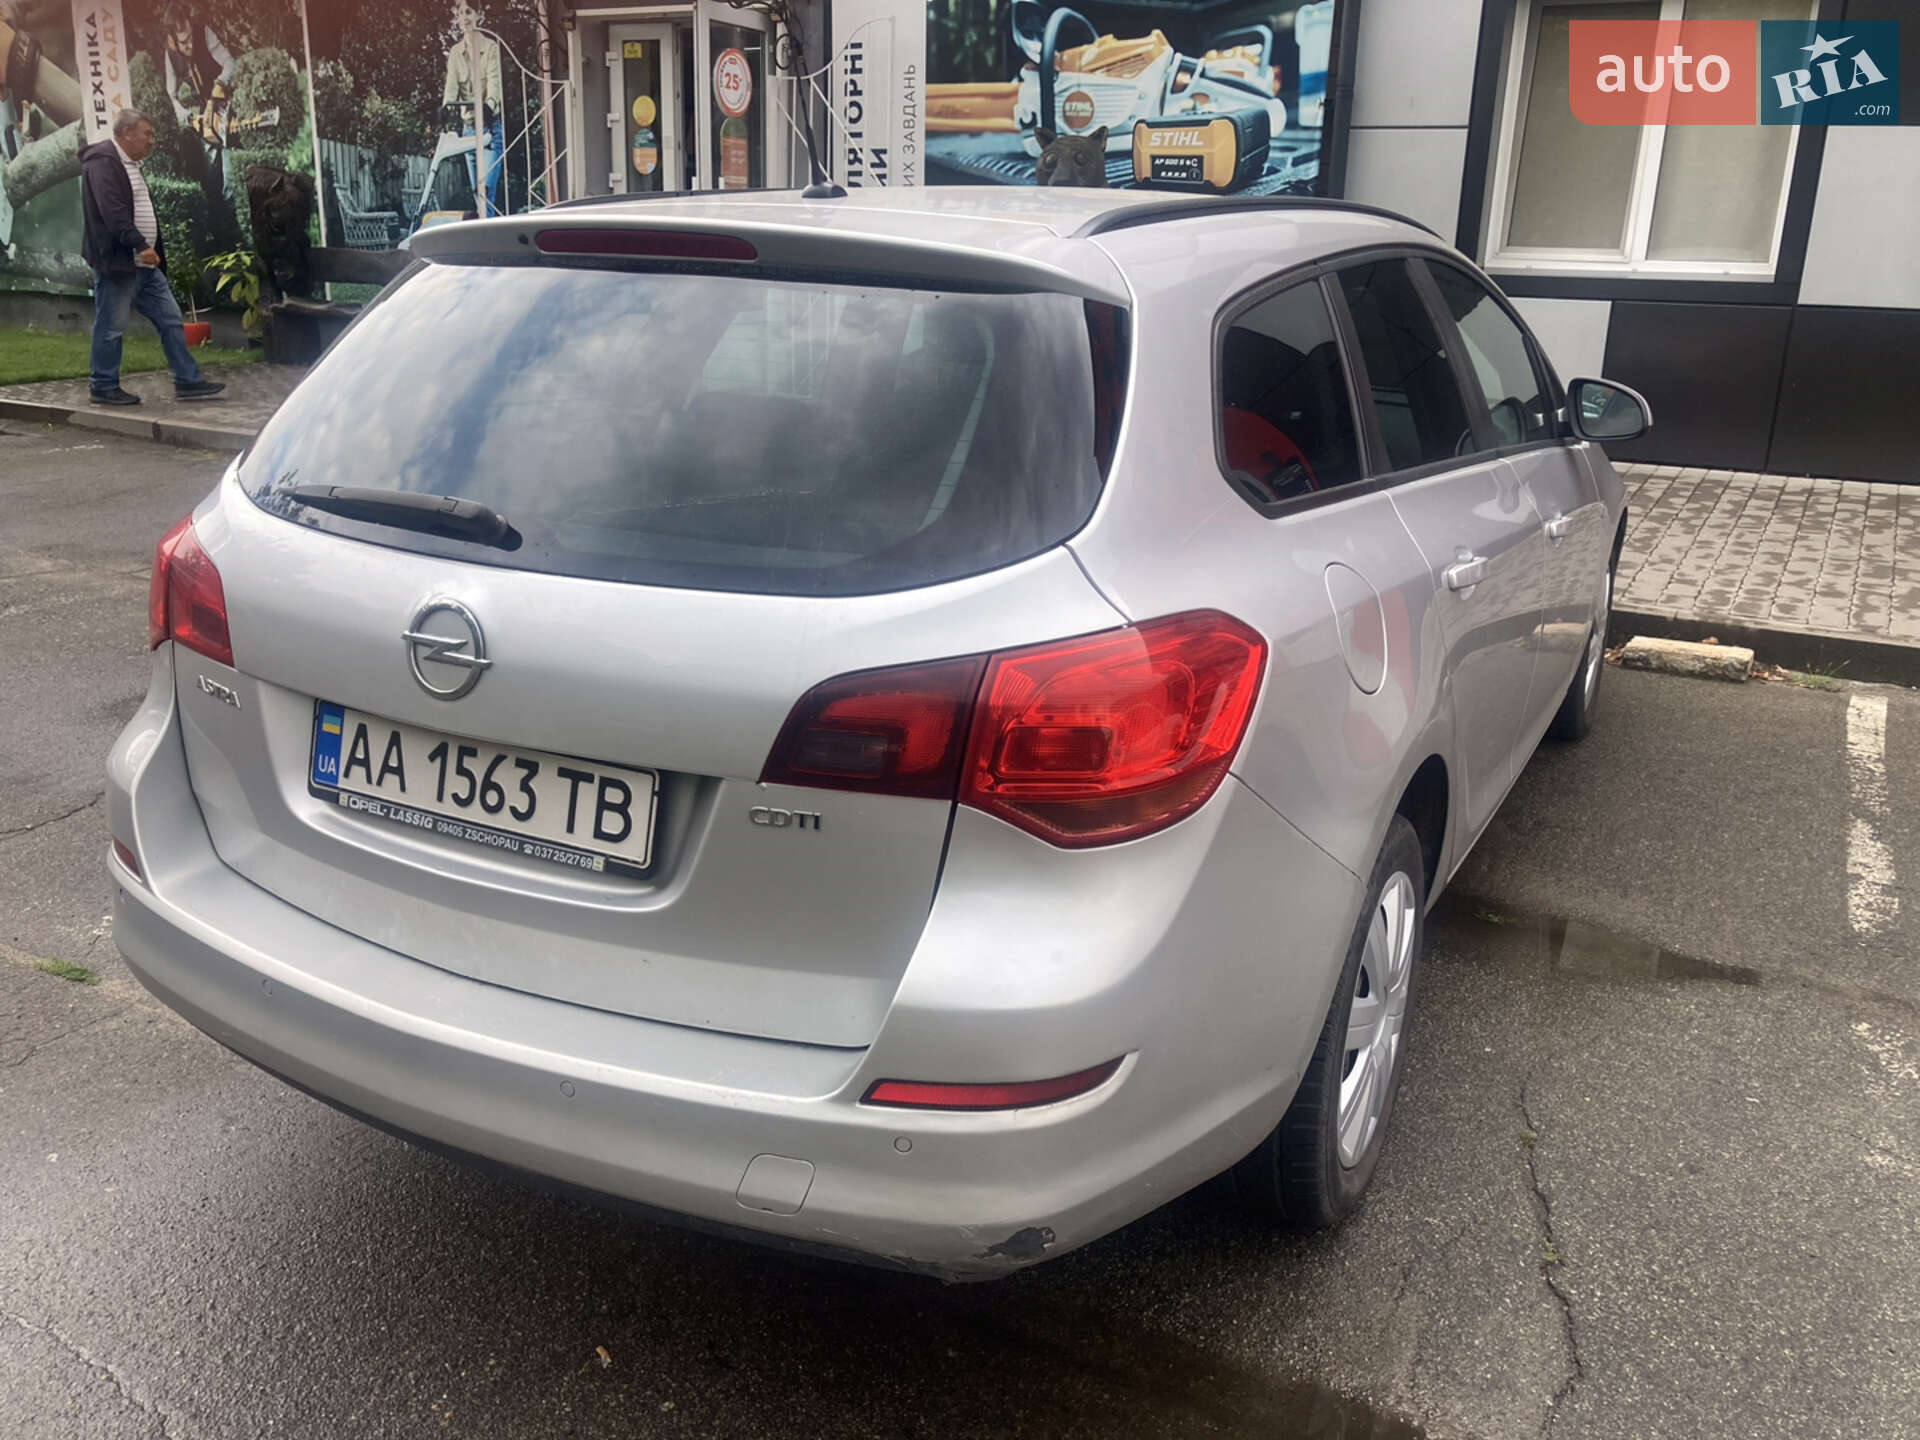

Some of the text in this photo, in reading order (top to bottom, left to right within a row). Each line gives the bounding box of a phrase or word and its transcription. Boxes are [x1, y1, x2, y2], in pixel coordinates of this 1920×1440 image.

[102, 8, 119, 82] САДУ
[85, 12, 107, 129] ТЕХНІКА
[903, 64, 917, 154] ЗАВДАНЬ
[1150, 131, 1204, 147] STIHL
[197, 675, 241, 709] ASTRA
[318, 754, 337, 776] UA
[343, 722, 632, 843] AA 1563 TB
[750, 806, 821, 830] CDTI
[437, 821, 464, 838] 09405
[464, 828, 519, 852] ZSCHOPAU
[534, 845, 593, 869] 03725/2769
